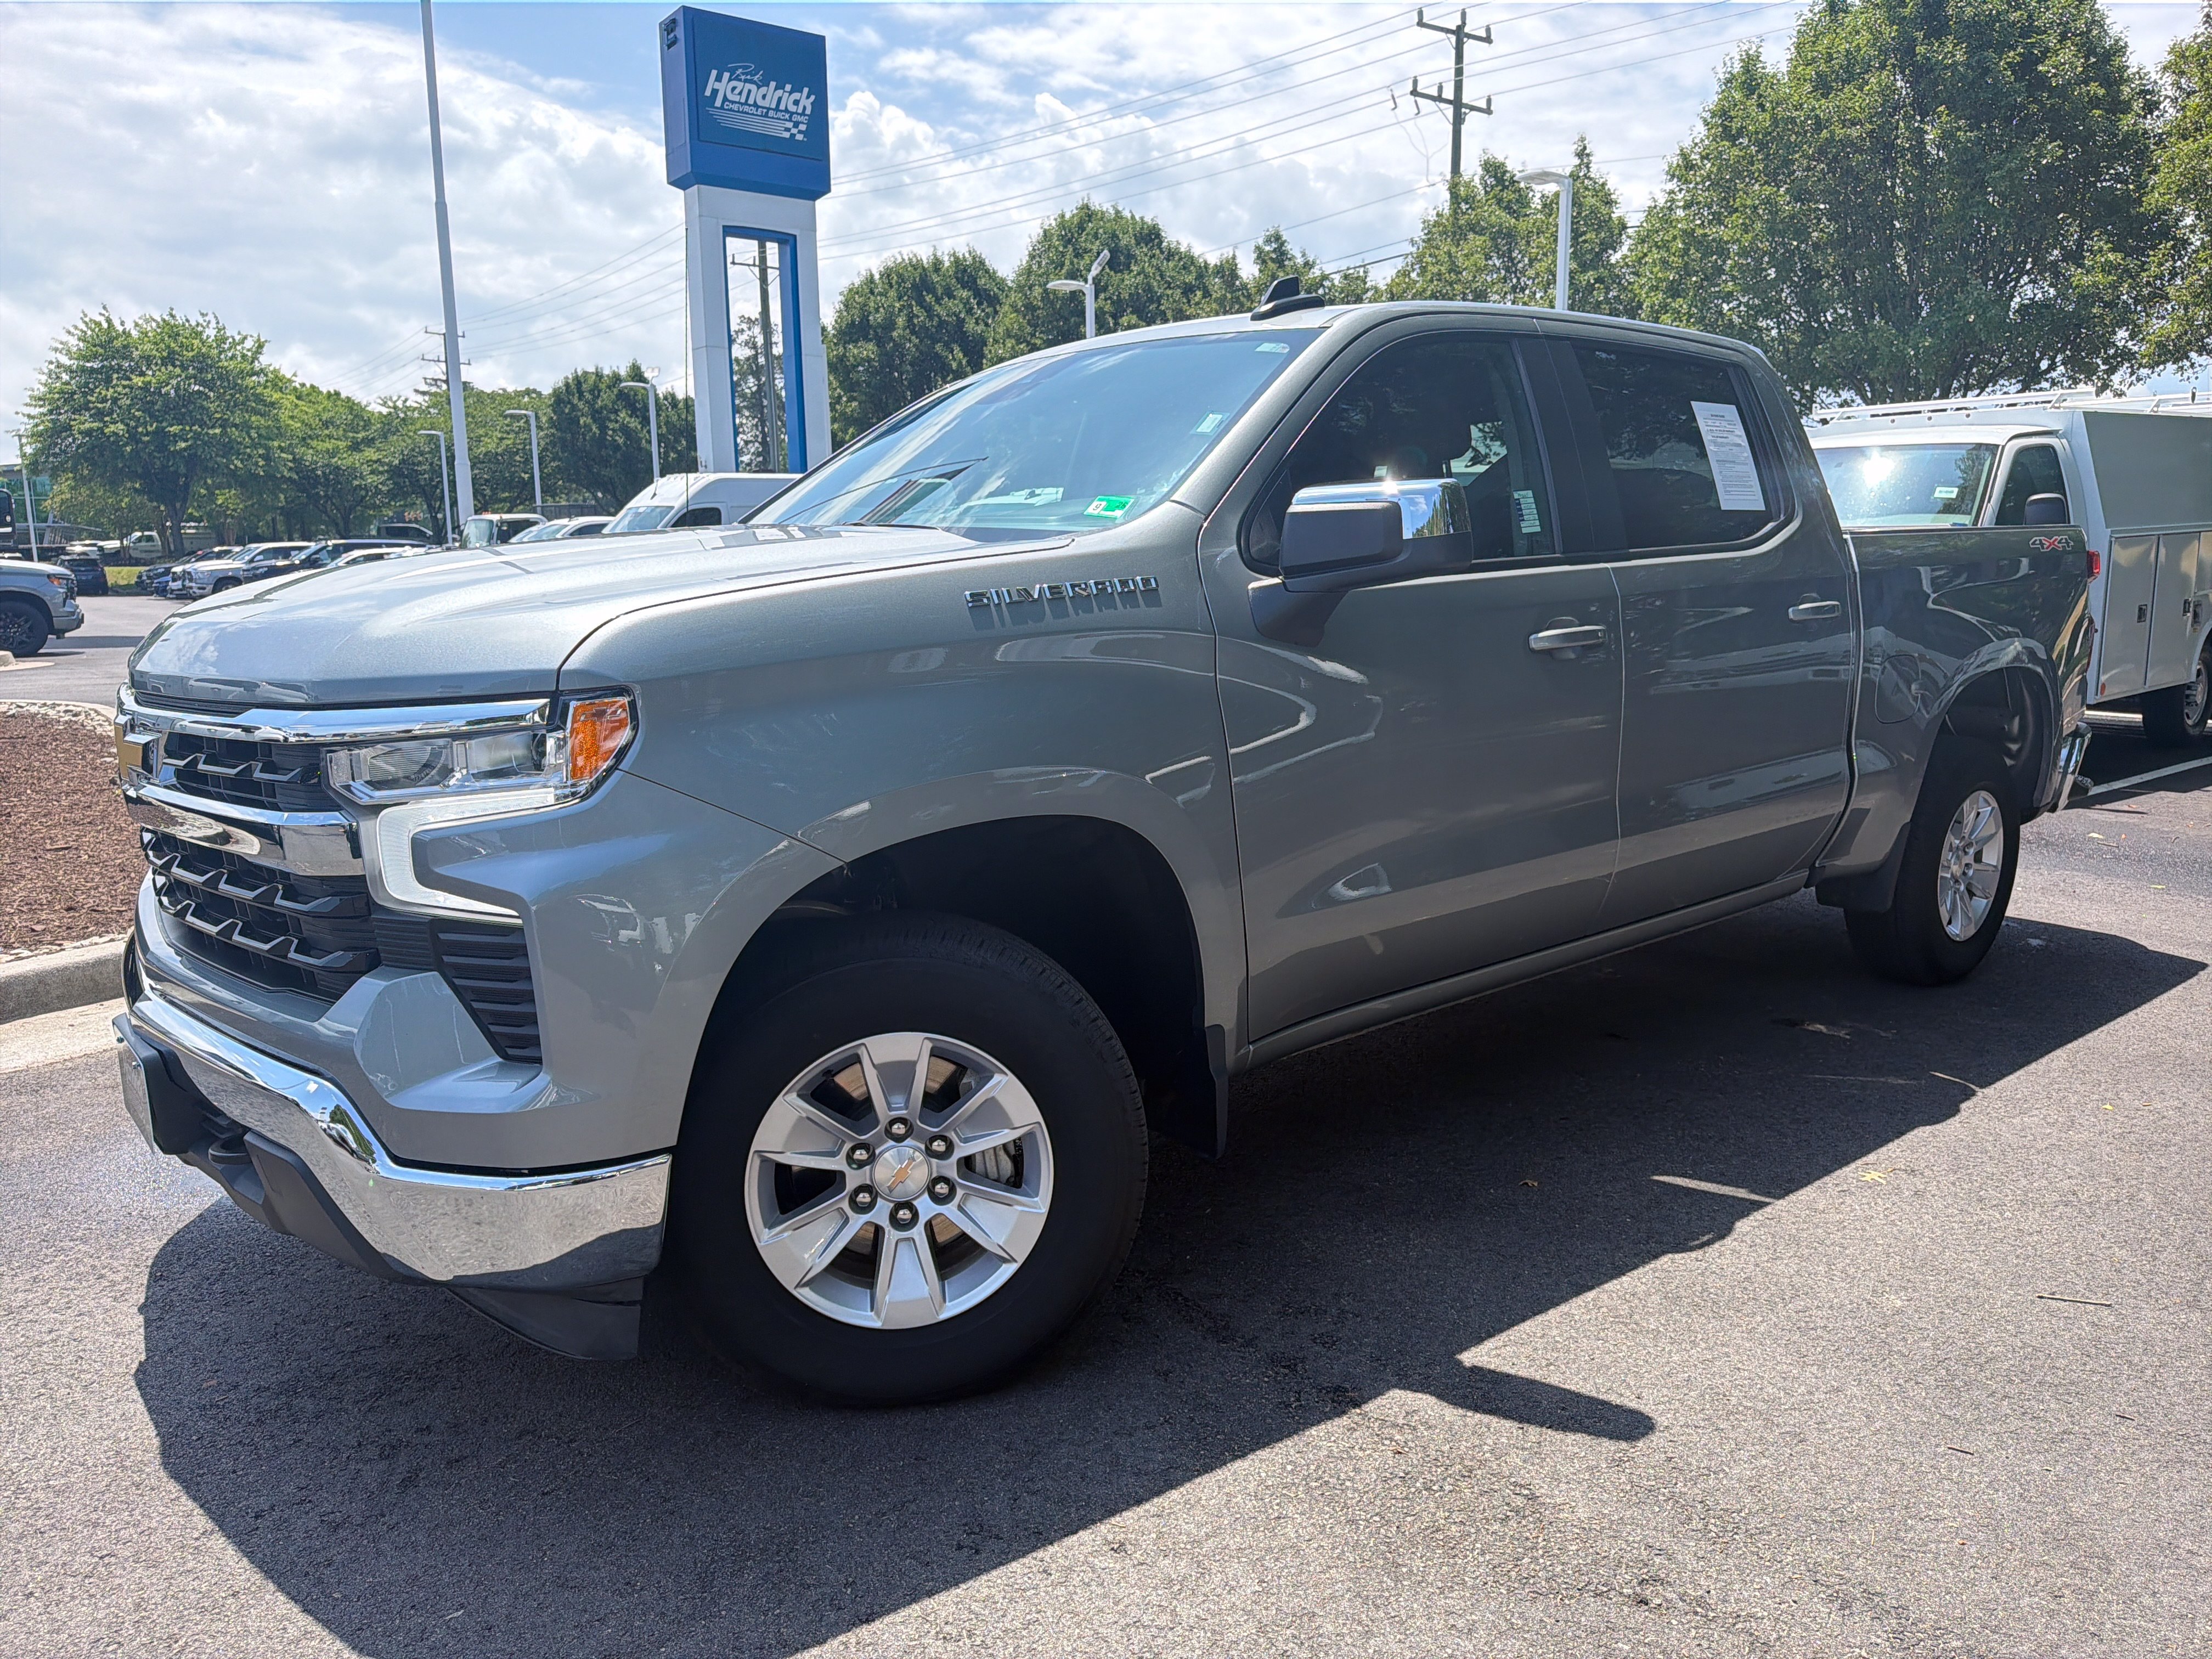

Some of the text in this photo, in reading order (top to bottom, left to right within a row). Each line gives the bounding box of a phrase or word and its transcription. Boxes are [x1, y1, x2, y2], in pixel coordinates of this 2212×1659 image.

[727, 63, 764, 86] Rick
[704, 70, 815, 114] Hendrick
[724, 101, 768, 115] CHEVROLET
[768, 110, 790, 120] BUICK
[964, 575, 1159, 607] SILVERADO
